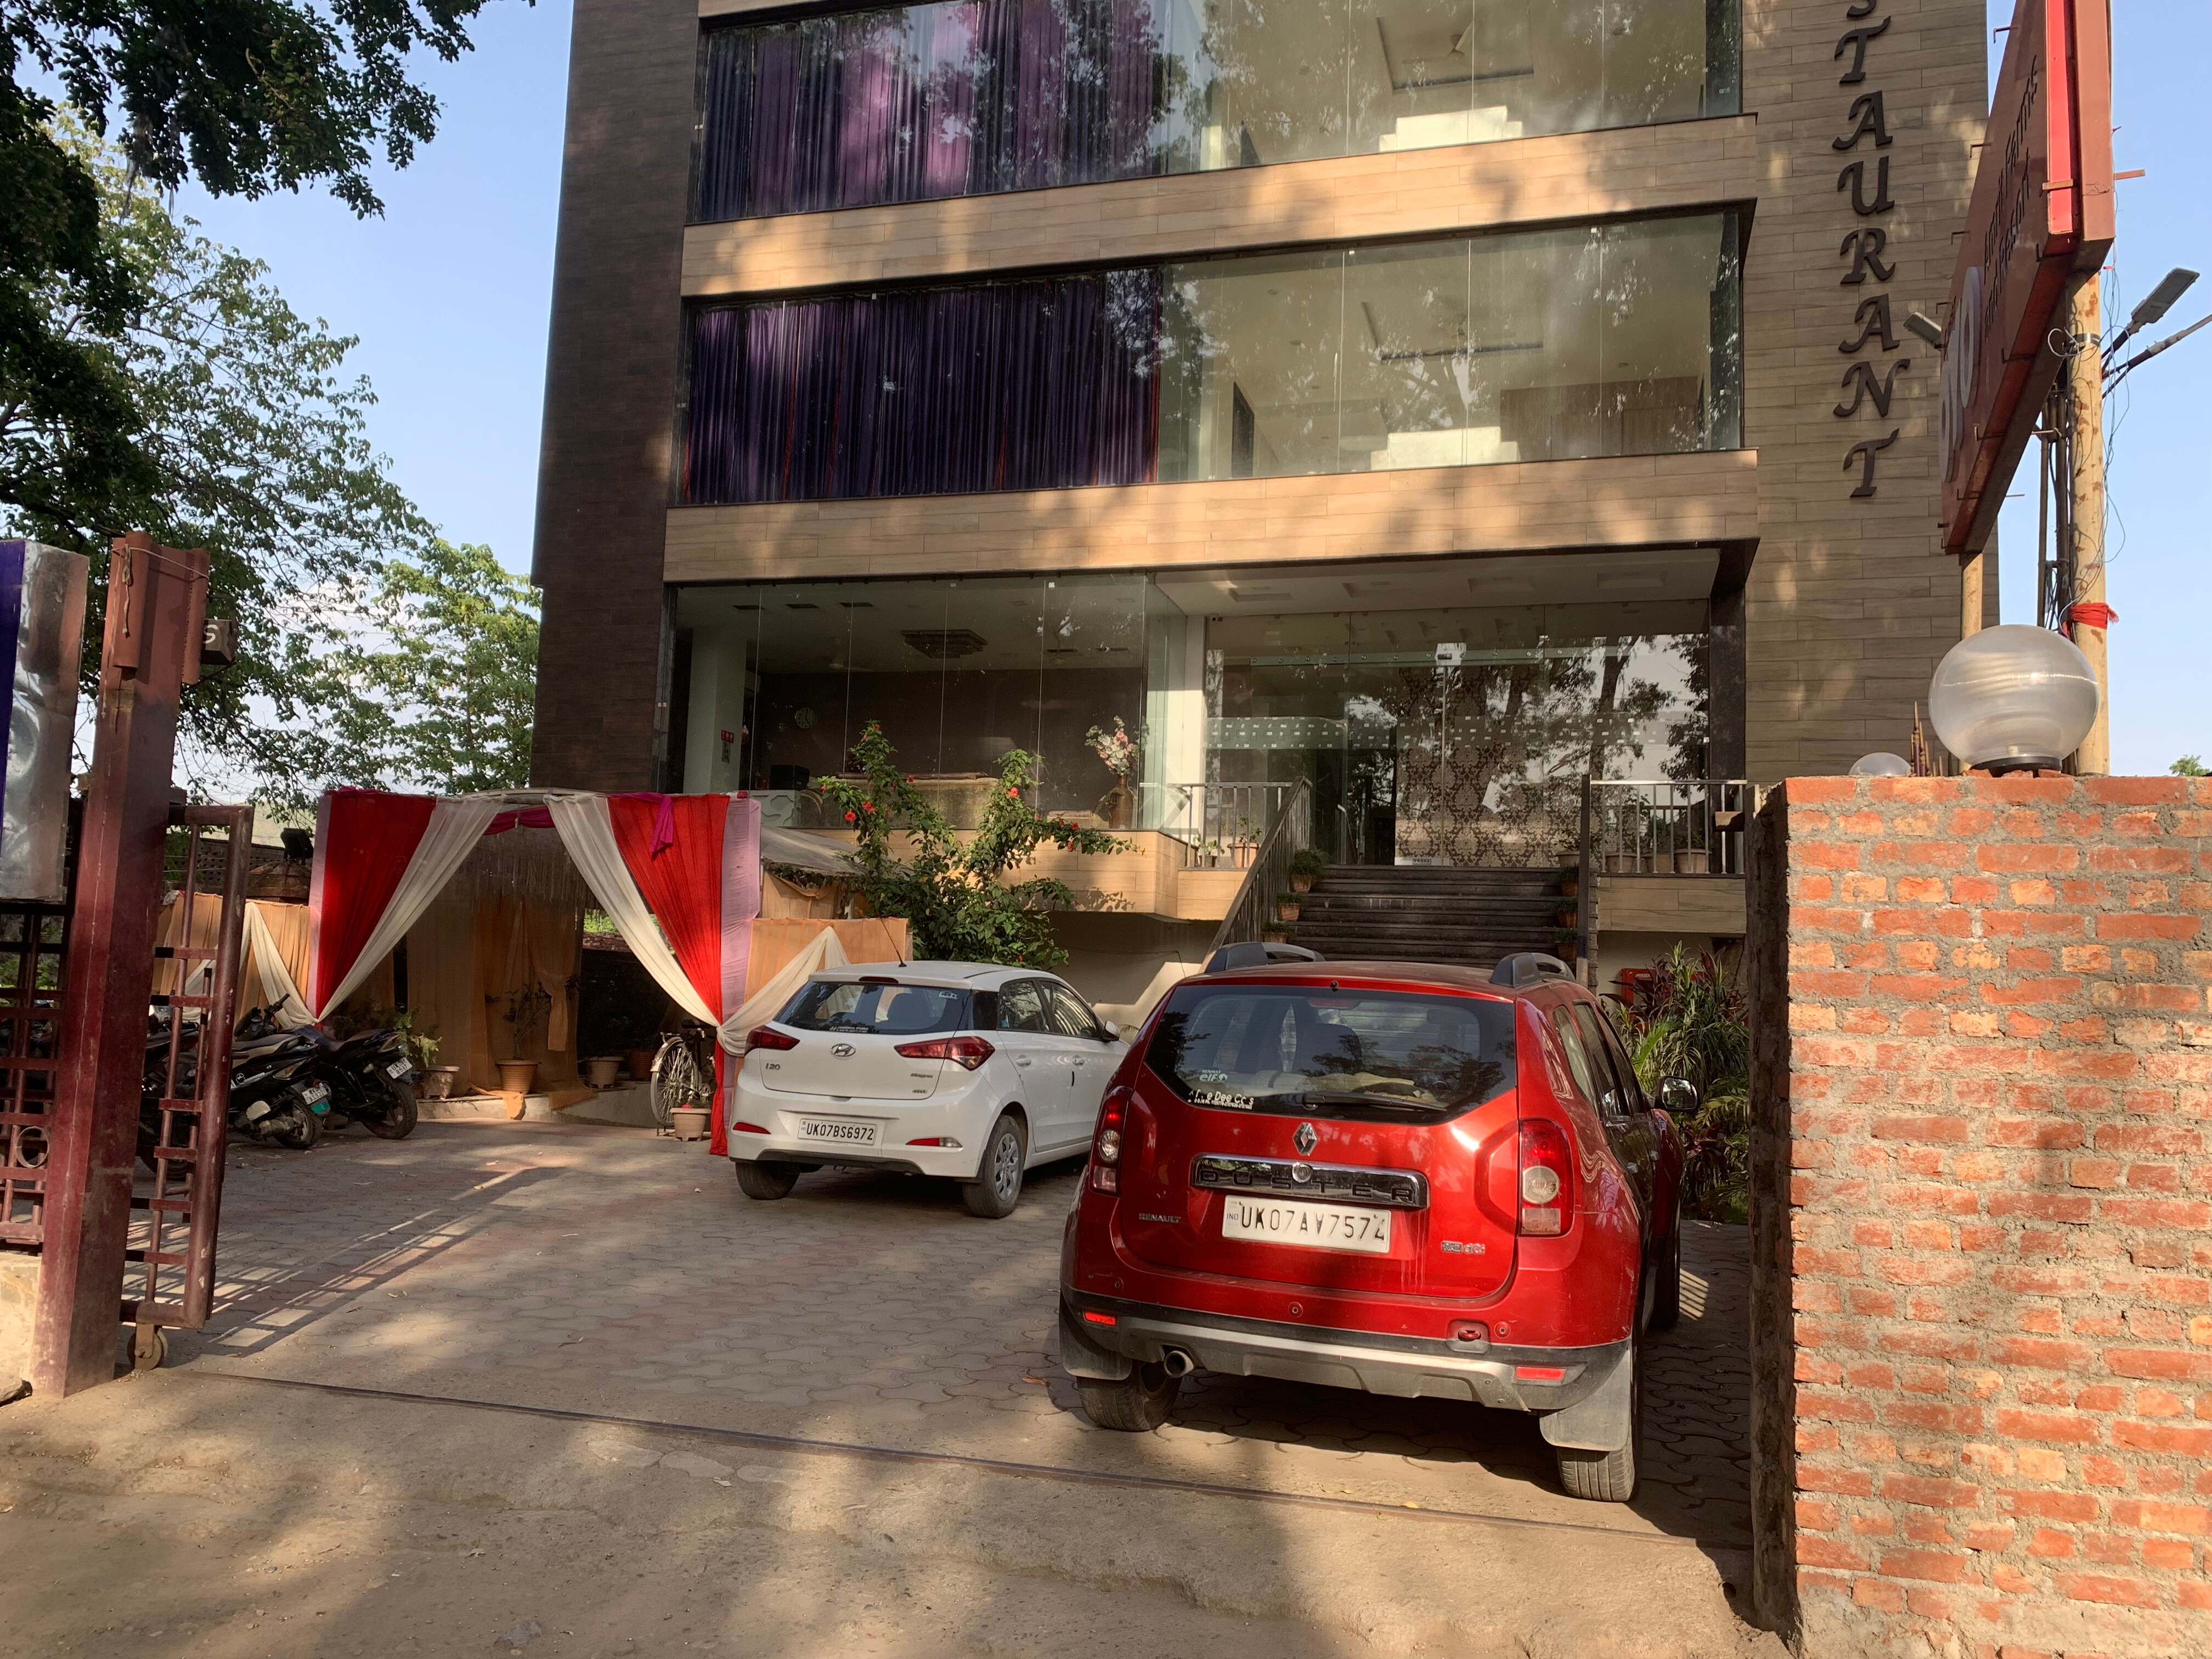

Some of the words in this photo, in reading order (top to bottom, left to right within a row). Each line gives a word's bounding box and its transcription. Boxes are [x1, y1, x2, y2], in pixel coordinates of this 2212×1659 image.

[2005, 54, 2038, 199] Farms
[1999, 146, 2031, 295] Resort
[1938, 266, 1982, 483] OYO
[1214, 1091, 1232, 1102] Dee
[806, 1122, 874, 1141] UK07BS6972
[1199, 1170, 1415, 1203] DUSTER
[1139, 1212, 1181, 1224] RENAULT
[1226, 1212, 1239, 1221] IND
[1242, 1205, 1386, 1242] UK07AV7574
